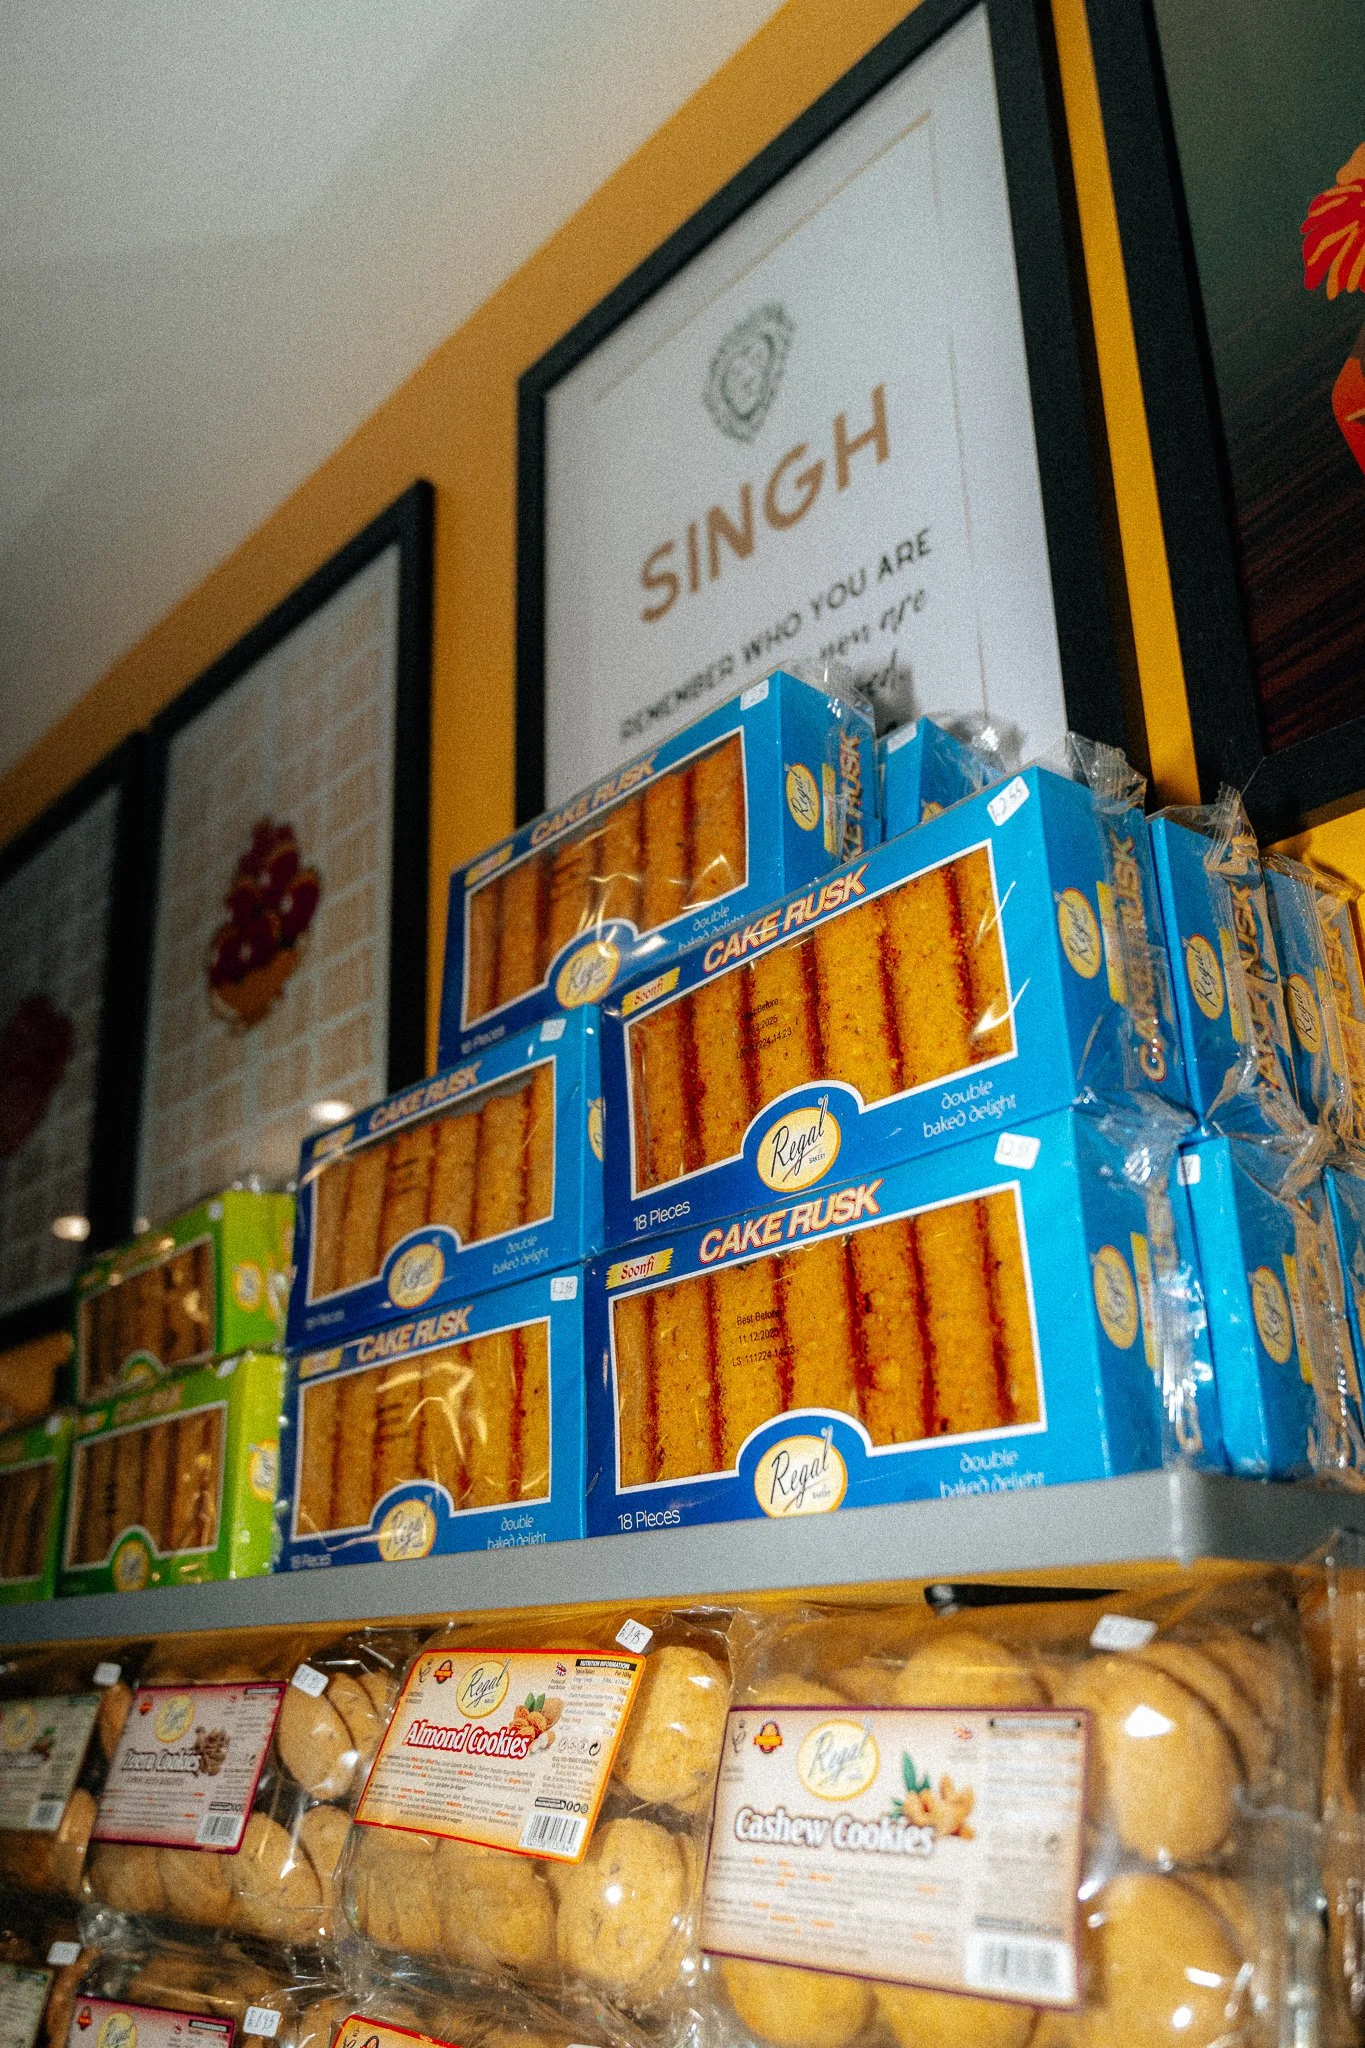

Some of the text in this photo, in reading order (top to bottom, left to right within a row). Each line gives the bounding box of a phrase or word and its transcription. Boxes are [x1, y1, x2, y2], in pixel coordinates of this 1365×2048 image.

[638, 382, 890, 624] SINGH
[619, 653, 735, 740] REMEMBER
[742, 610, 803, 664] WHO
[810, 568, 867, 620] YOU
[877, 527, 932, 584] ARE
[786, 764, 813, 824] Regal
[692, 904, 730, 932] double
[702, 862, 870, 974] CAKE RUSK
[633, 977, 664, 1005] Soonfi
[1182, 936, 1218, 1008] Regal
[757, 998, 779, 1013] Before
[1283, 974, 1317, 1043] Regal
[941, 1079, 993, 1110] double
[770, 1093, 829, 1176] Regal
[923, 1093, 1017, 1138] baked delight
[808, 1152, 826, 1164] BAKERY
[632, 1200, 691, 1231] 18 Pieces
[700, 1178, 884, 1264] CAKE RUSK
[620, 1255, 655, 1281] Soonfi
[736, 1314, 753, 1326] Best
[356, 1322, 413, 1363] CAKE
[770, 1425, 833, 1508] Regal
[960, 1448, 1020, 1474] double
[501, 1514, 534, 1532] double
[617, 1509, 681, 1530] 18 Pieces
[461, 1658, 512, 1708] Regal
[402, 1719, 532, 1760] Almond Cookies
[734, 1804, 936, 1858] Cashew Cookies
